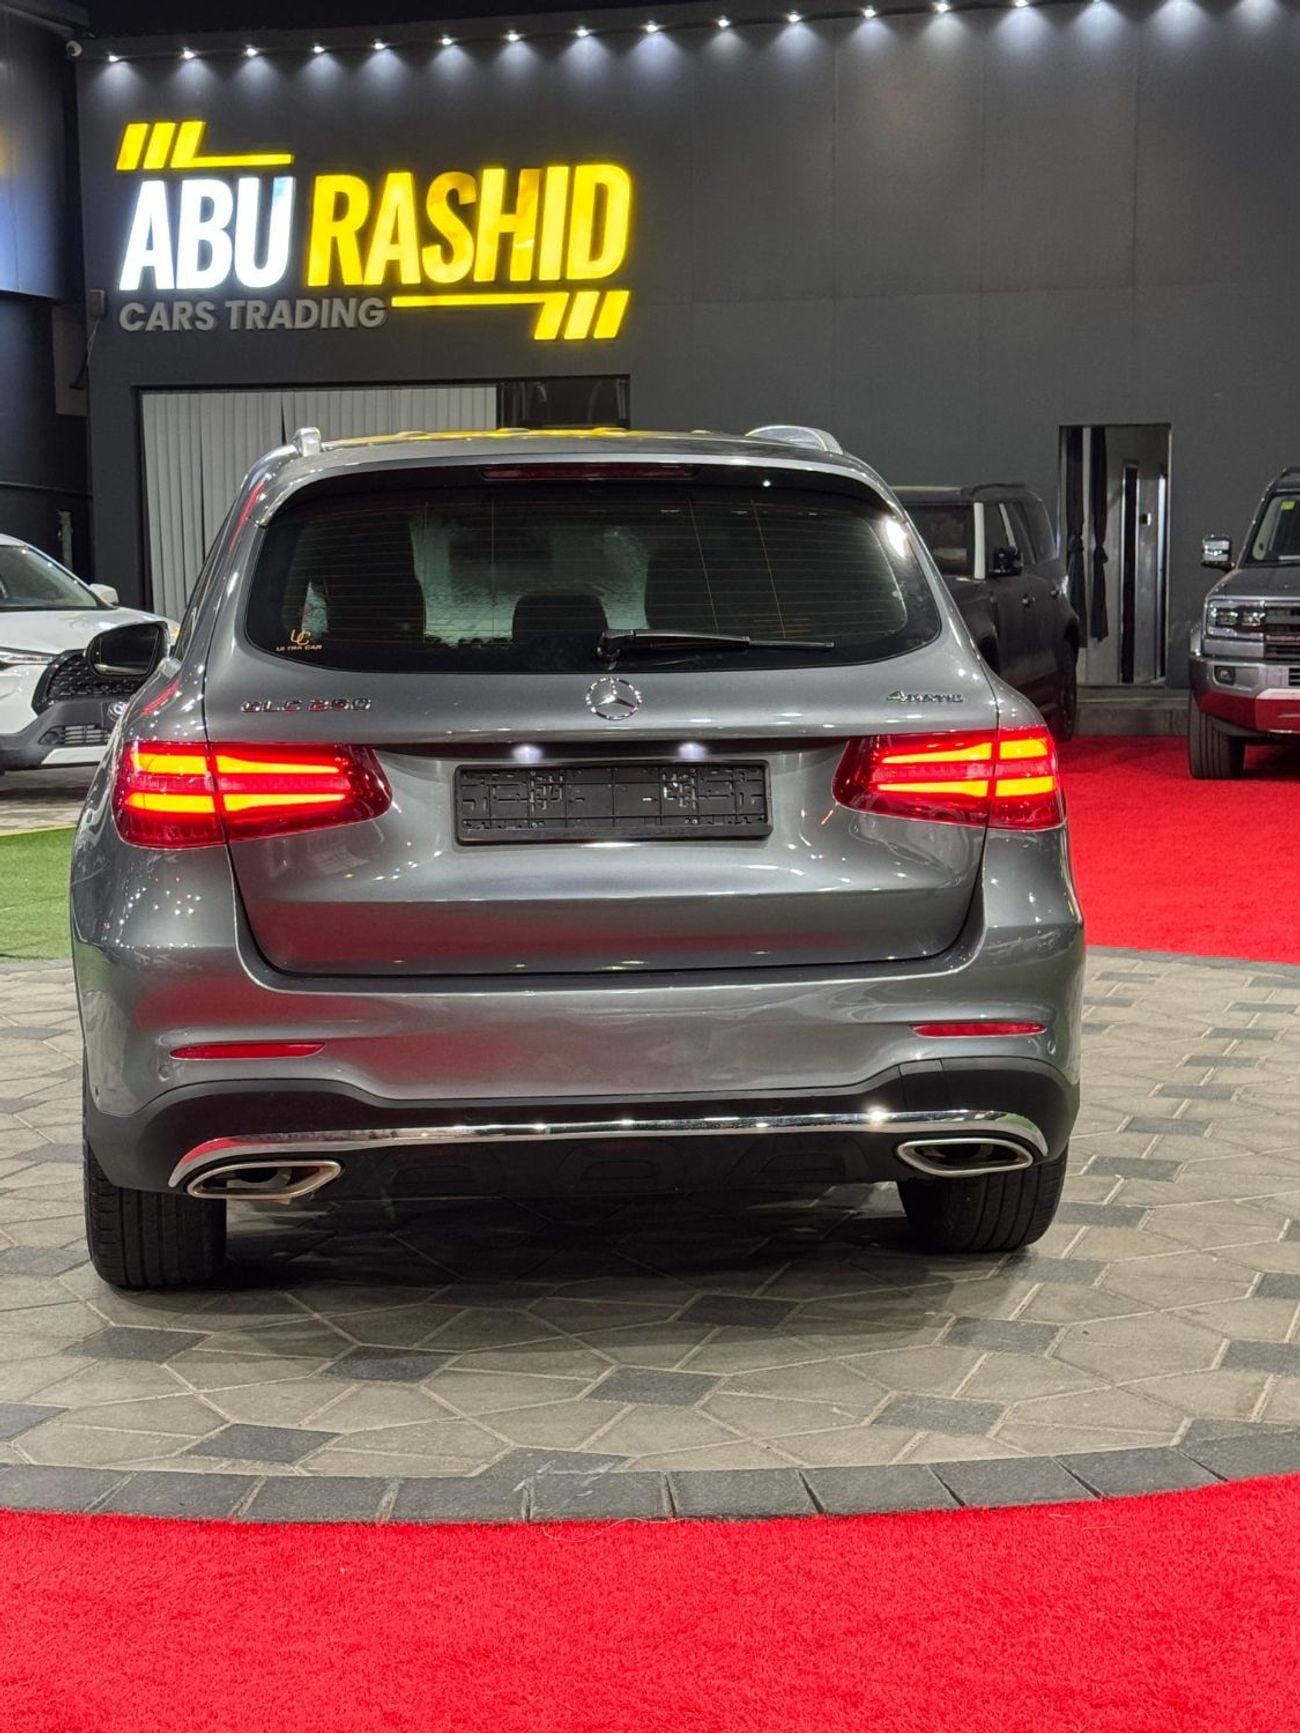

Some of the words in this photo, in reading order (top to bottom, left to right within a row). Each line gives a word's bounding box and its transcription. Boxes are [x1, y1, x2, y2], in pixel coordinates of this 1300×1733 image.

[119, 176, 296, 290] ABU
[307, 164, 631, 287] RASHID
[119, 301, 216, 332] CARS
[224, 297, 387, 330] TRADING
[241, 700, 302, 713] GLC
